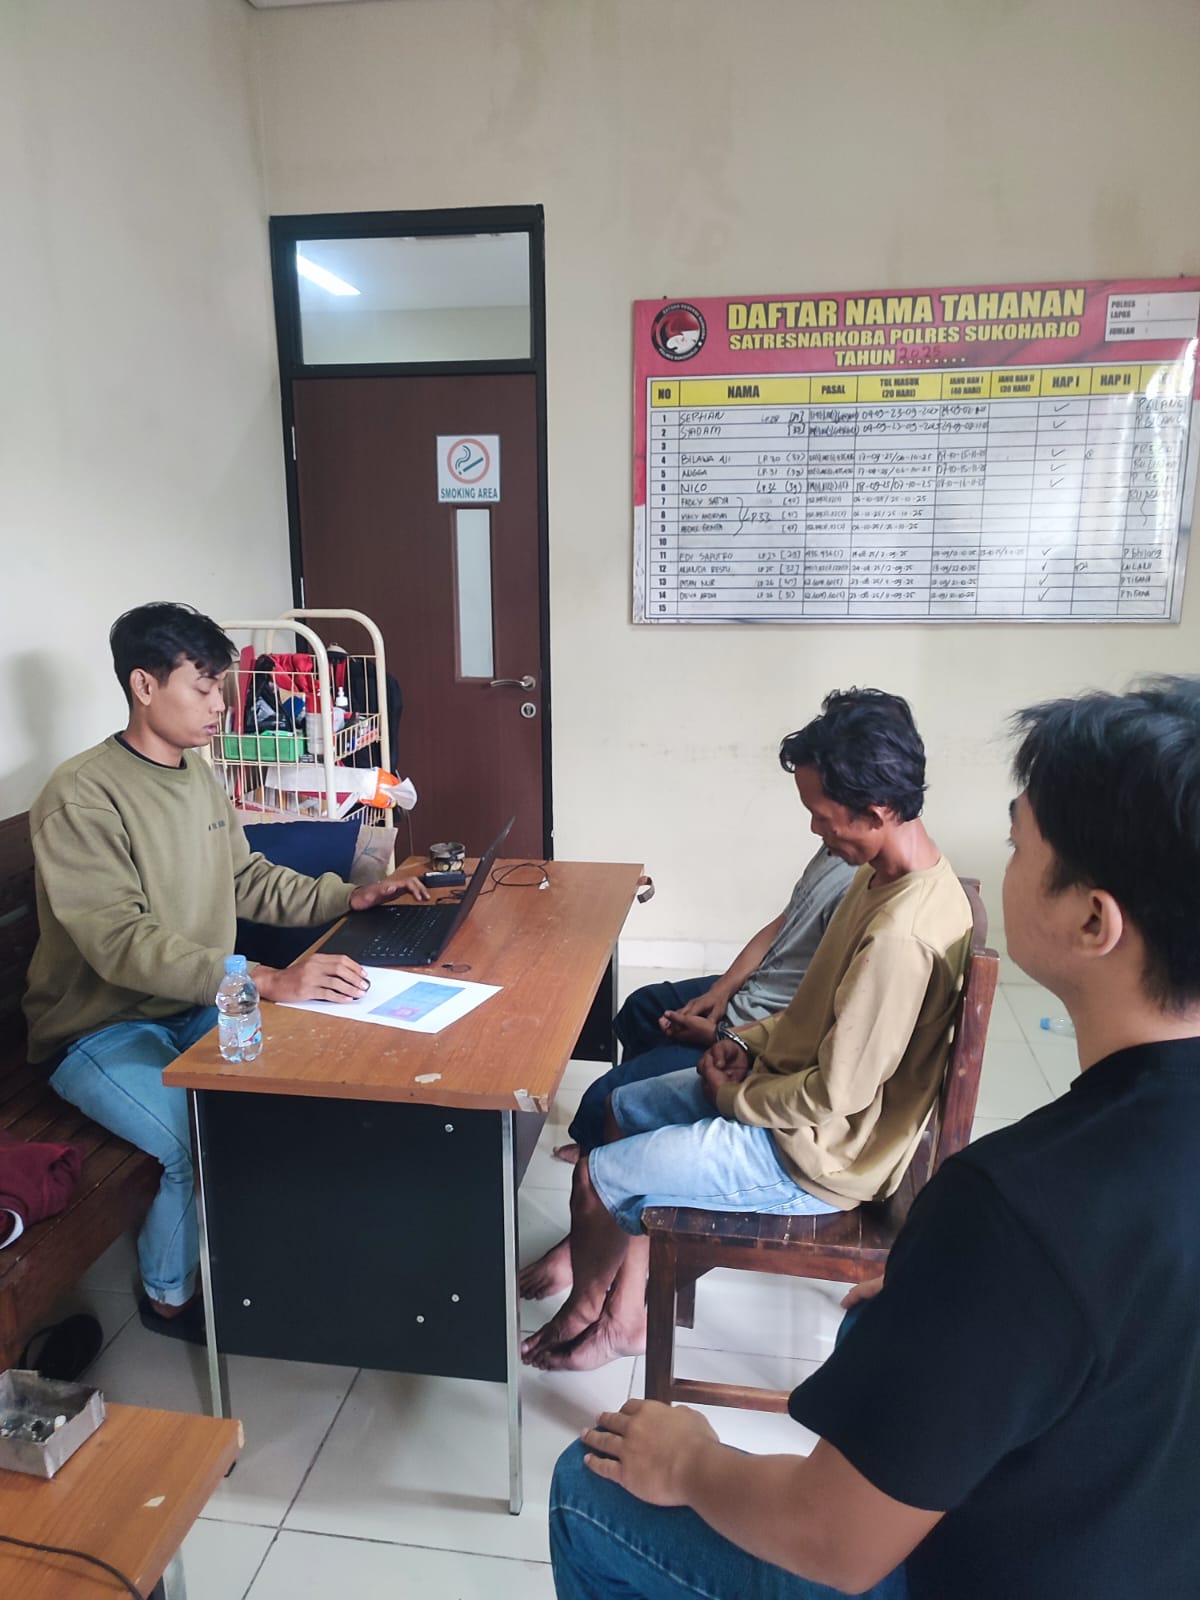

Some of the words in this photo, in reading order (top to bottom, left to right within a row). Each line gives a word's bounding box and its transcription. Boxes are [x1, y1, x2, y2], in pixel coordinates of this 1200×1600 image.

[727, 300, 838, 331] DAFTAR
[845, 294, 934, 327] NAMA
[940, 288, 1086, 322] TAHANAN
[729, 329, 885, 351] SATRESNARKOBA
[889, 326, 960, 345] POLRES
[964, 320, 1081, 342] SUKOHARJO
[835, 349, 896, 367] TAHUN
[1052, 376, 1072, 388] HAP
[1075, 375, 1079, 387] I
[1100, 374, 1122, 386] HAP
[1123, 373, 1131, 386] II
[658, 388, 671, 400] NO
[727, 385, 760, 399] NAMA
[821, 384, 845, 395] PASAL
[661, 456, 666, 464] 4
[661, 470, 666, 478] 5
[441, 488, 475, 499] SMOKING
[478, 487, 498, 498] AREA
[659, 538, 667, 546] 10
[659, 565, 667, 573] 12
[659, 578, 667, 586] 13
[659, 604, 667, 612] 15
